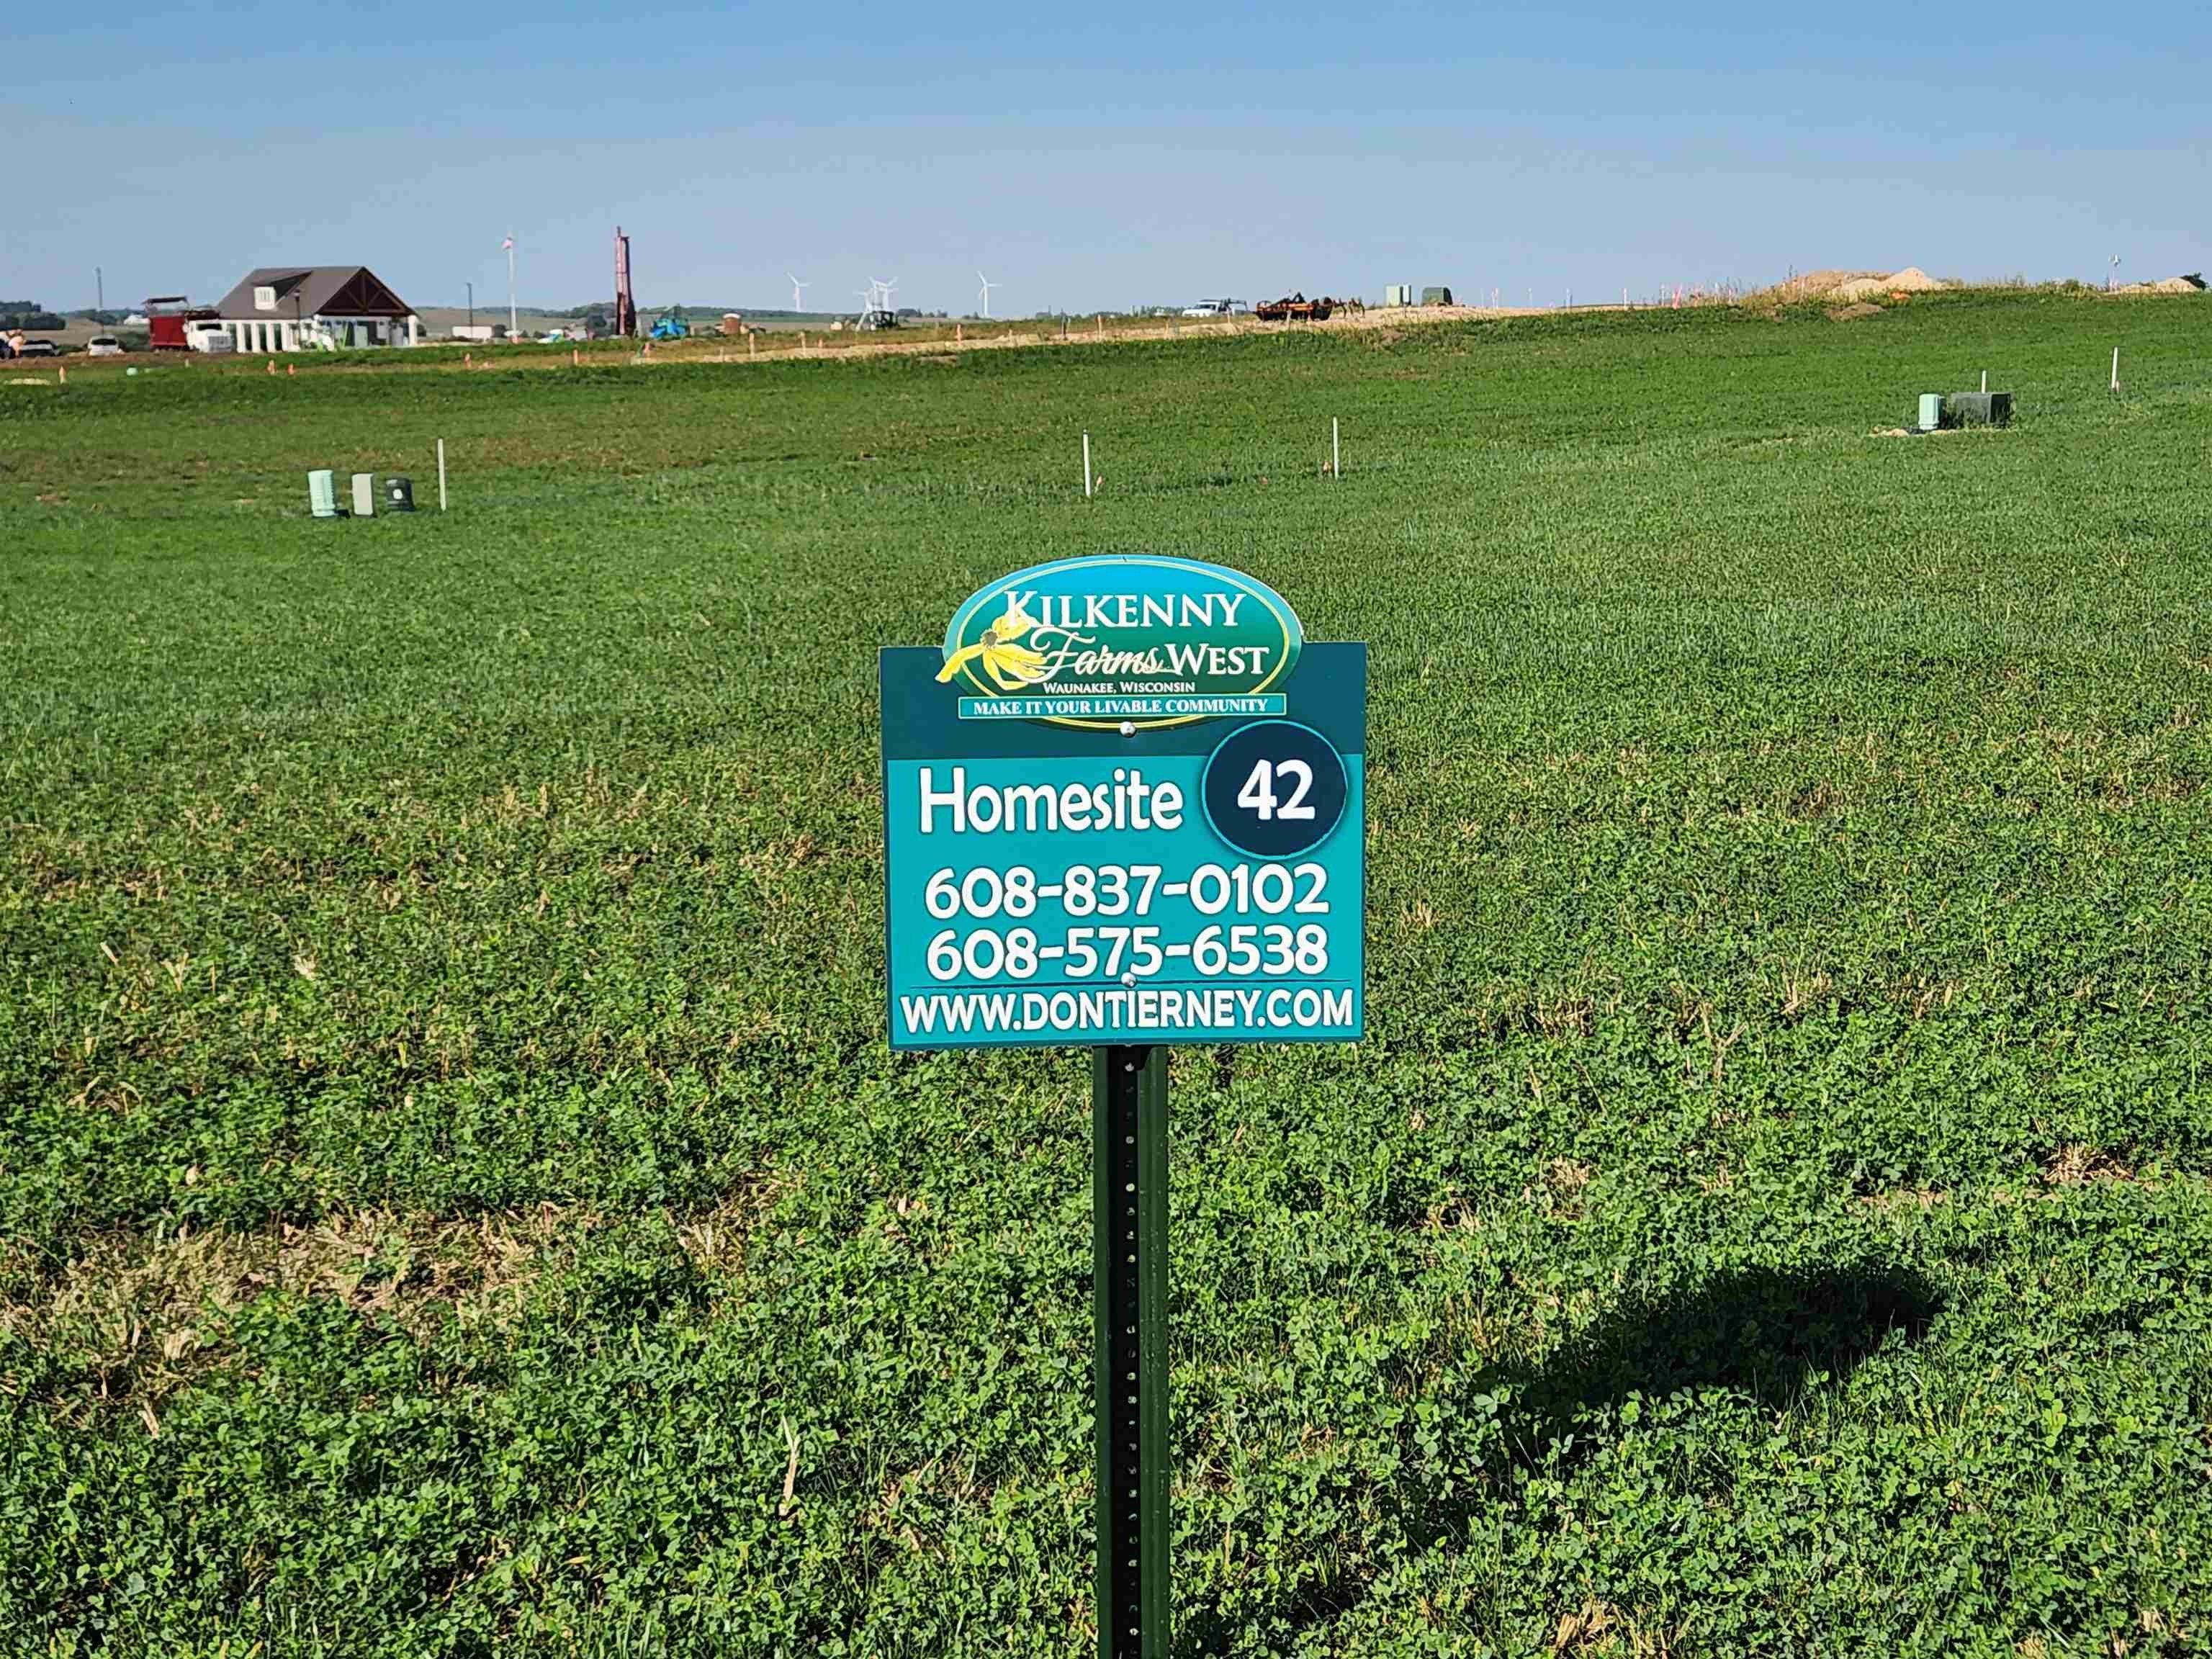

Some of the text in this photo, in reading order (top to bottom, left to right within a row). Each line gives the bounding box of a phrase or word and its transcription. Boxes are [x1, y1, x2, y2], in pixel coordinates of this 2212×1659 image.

[1004, 590, 1247, 628] KILKENNY
[1029, 625, 1270, 683] Farms WEST
[974, 697, 1268, 716] MAKE IT YOUR LIVABLE COMMUNITY
[1043, 680, 1195, 695] WAUNAKEE, WISCONSIN
[919, 759, 1316, 833] Homesite 42
[925, 863, 1329, 920] 608-837-0102
[927, 925, 1328, 980] 608-575-6538
[901, 989, 1354, 1033] WWW.DONTIERNEY.COM
